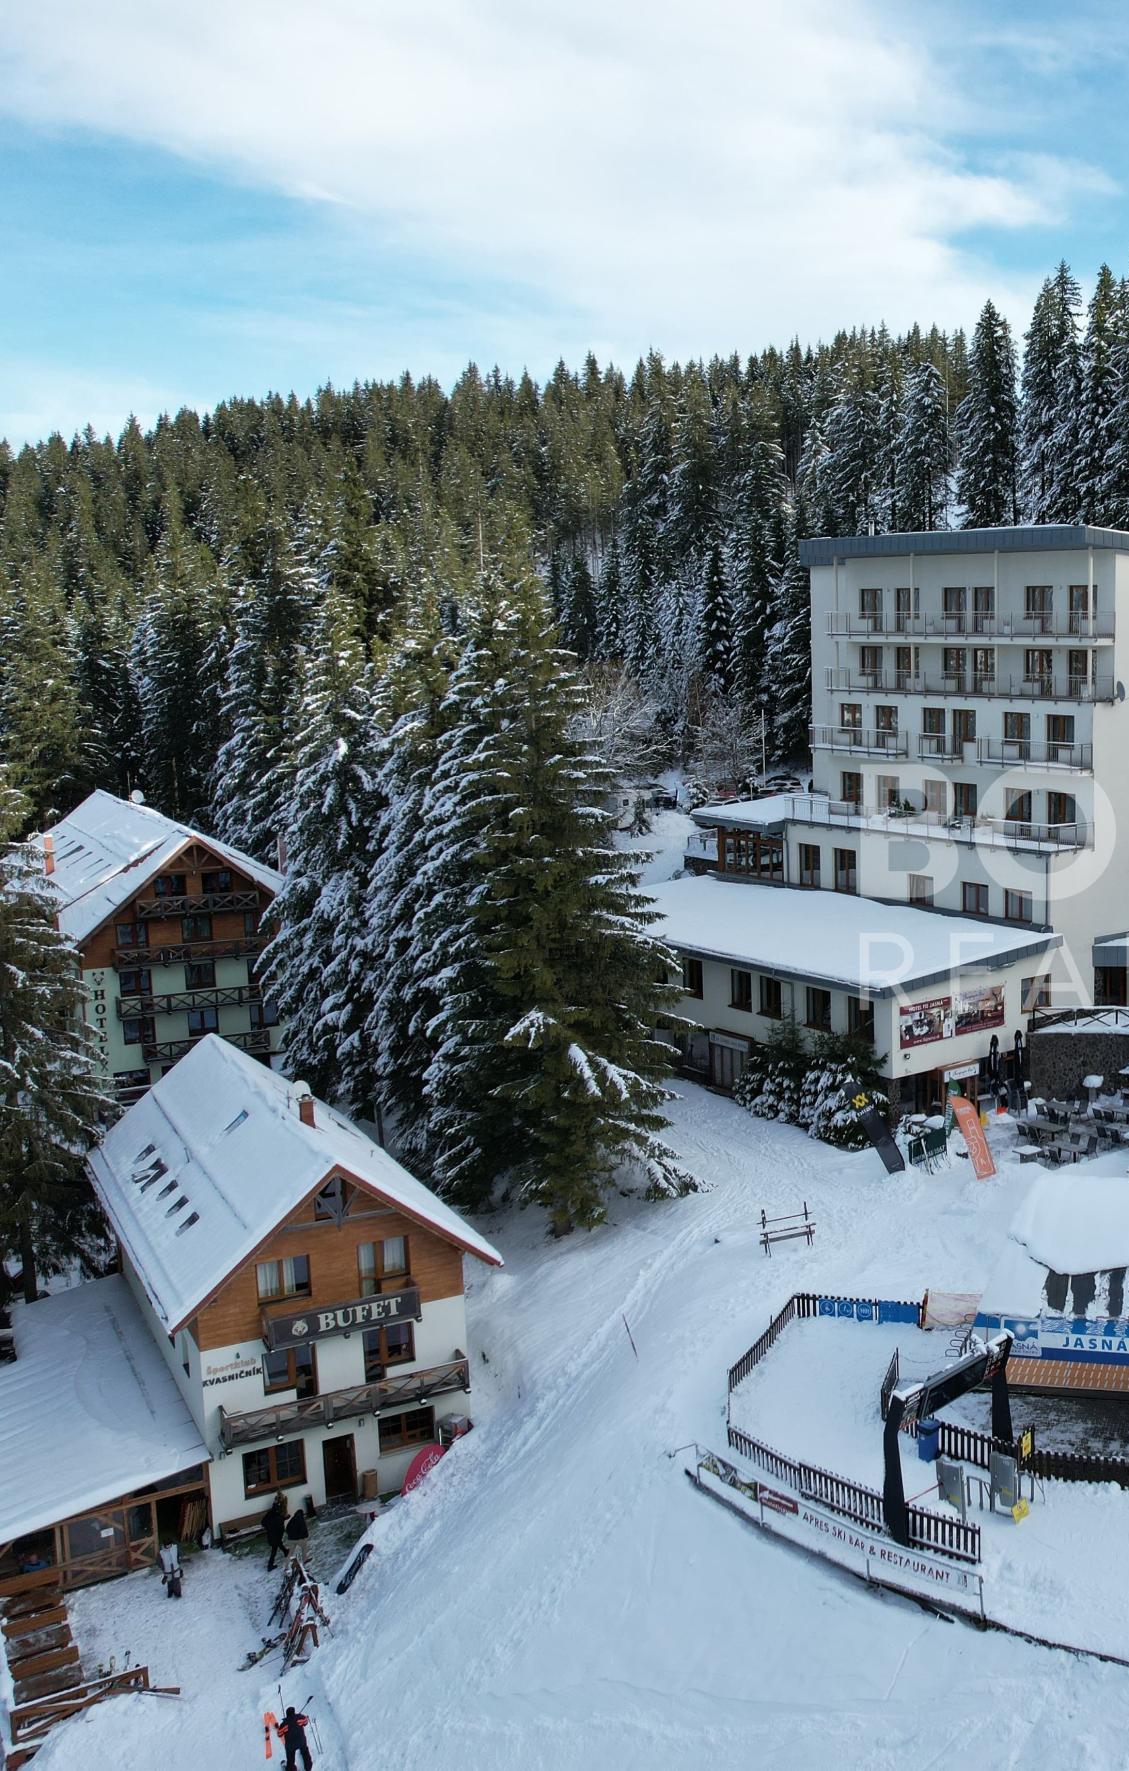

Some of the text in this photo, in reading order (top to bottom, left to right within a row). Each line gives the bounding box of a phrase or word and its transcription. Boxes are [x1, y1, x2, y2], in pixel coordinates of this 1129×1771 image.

[94, 989, 109, 1057] HOTEL
[317, 1297, 402, 1332] BUFET
[1062, 1336, 1128, 1352] JASNÁ
[202, 1366, 263, 1387] KVASNIČNÍK
[803, 1511, 830, 1533] APRES
[832, 1524, 847, 1542] SKI
[869, 1545, 876, 1556] &
[880, 1549, 951, 1584] RESTAURANT
